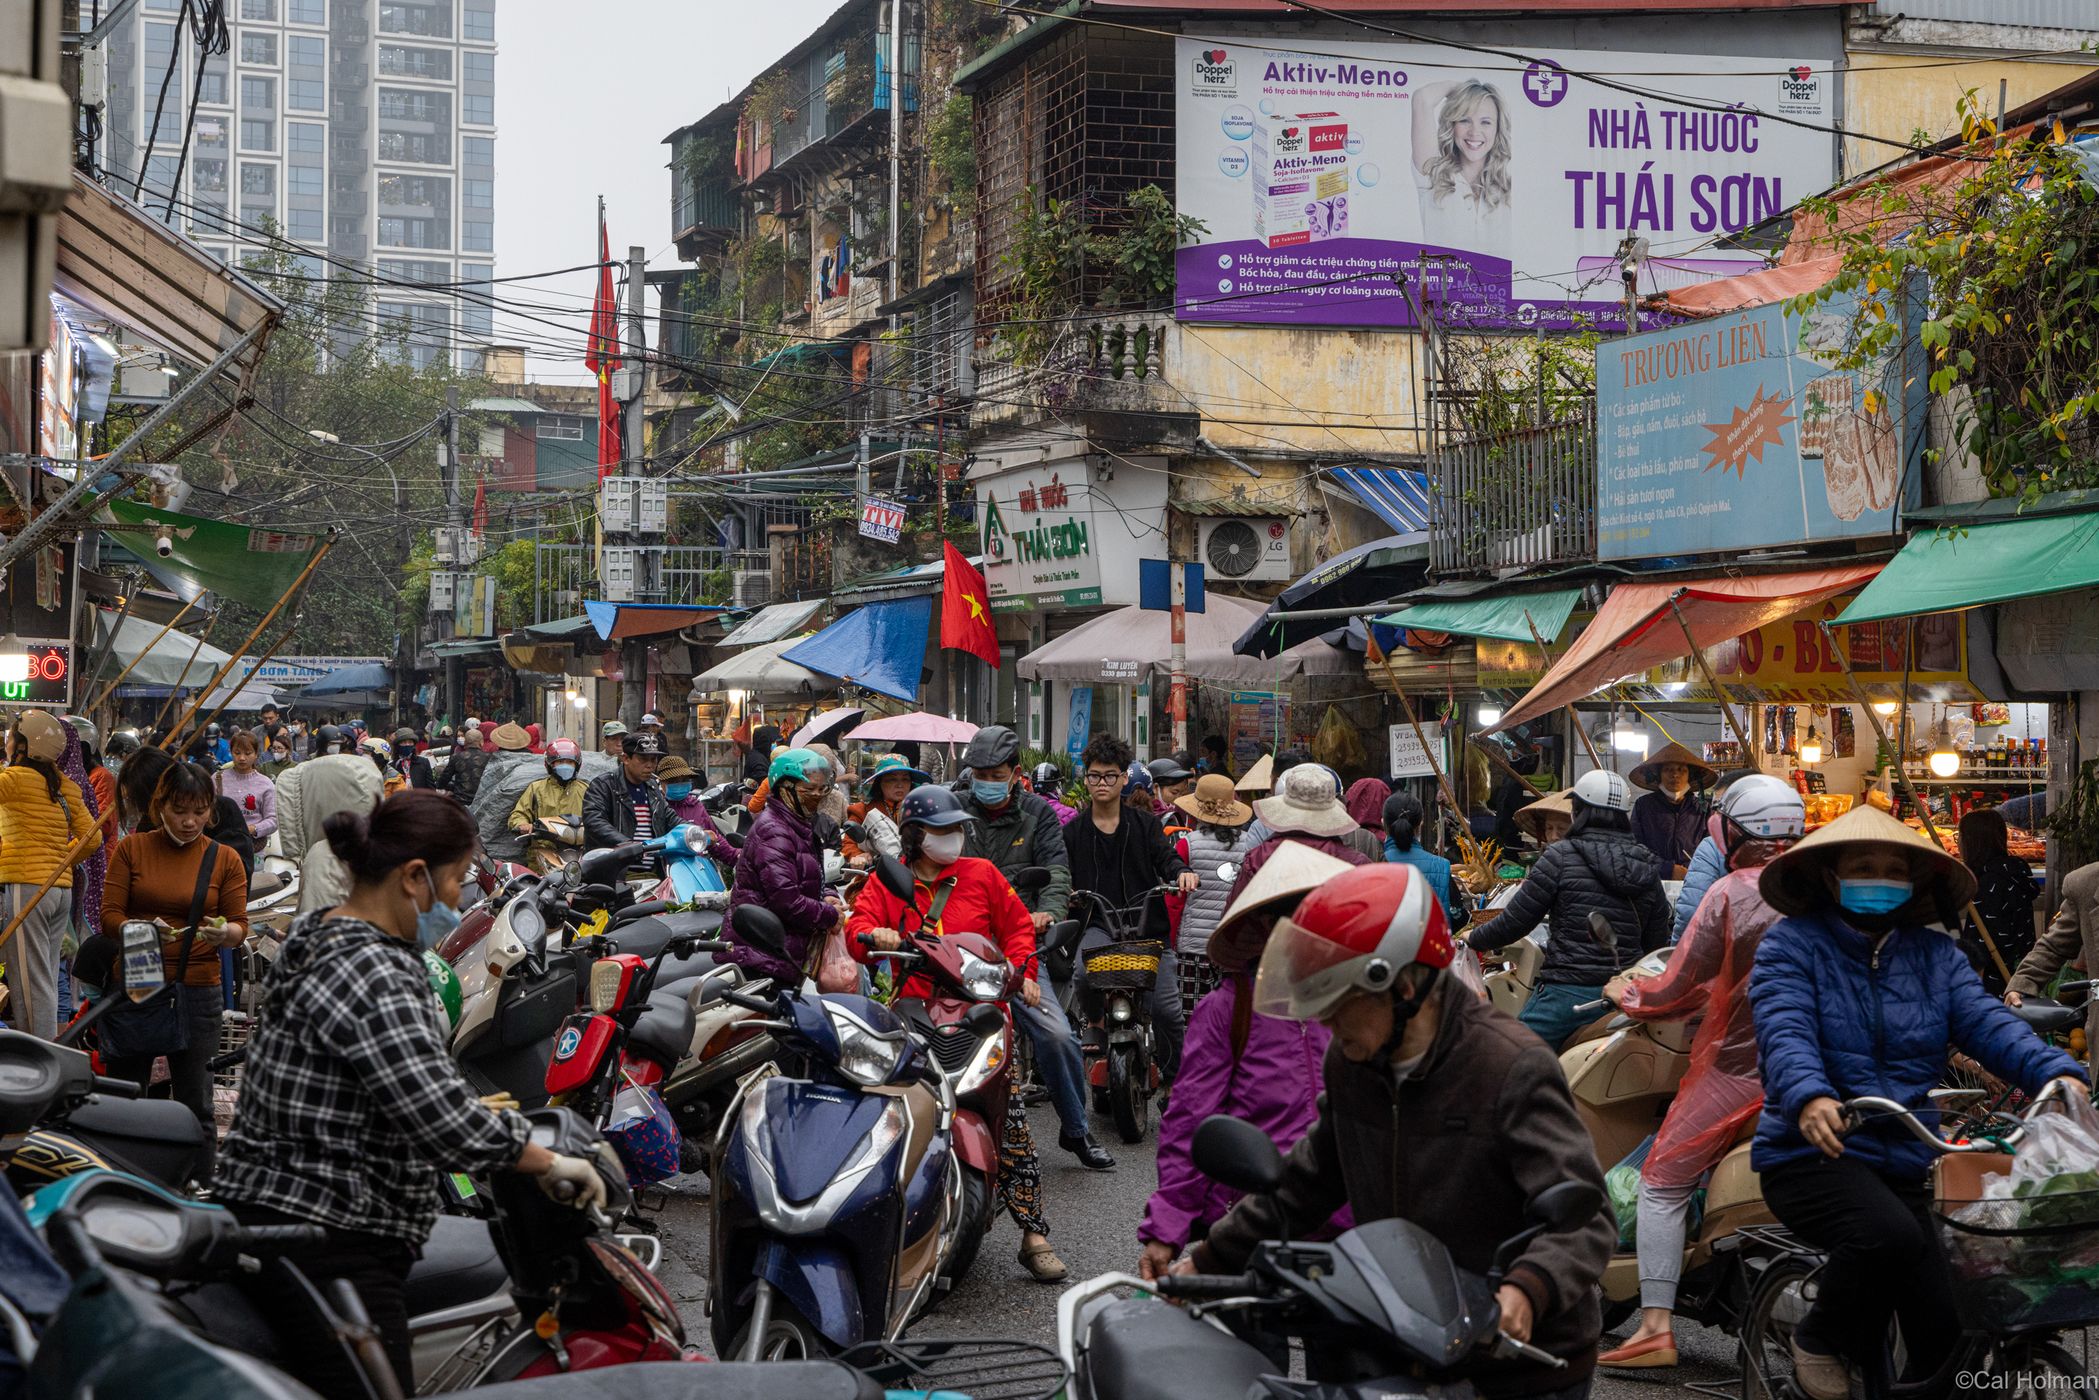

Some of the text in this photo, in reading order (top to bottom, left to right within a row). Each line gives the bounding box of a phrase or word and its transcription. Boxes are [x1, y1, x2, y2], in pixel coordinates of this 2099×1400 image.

[1196, 63, 1233, 78] Doppel
[1263, 61, 1408, 87] Aktiv-Meno
[1263, 86, 1273, 95] Hỗ
[1275, 88, 1285, 96] trợ
[1300, 88, 1318, 97] thiện
[1319, 89, 1336, 98] triệu
[1337, 90, 1360, 99] chứng
[1394, 92, 1409, 100] kinh
[1782, 79, 1817, 93] Doppel
[1588, 101, 1759, 153] NHÀ THUỐC
[1276, 138, 1303, 148] Doppel
[1314, 132, 1344, 143] aktiv
[1273, 154, 1347, 170] Aktiv-Meno
[1565, 160, 1782, 232] THÁI SƠN
[1239, 253, 1254, 265] Hỗ
[1256, 256, 1272, 267] trợ
[1273, 255, 1299, 268] giảm
[1301, 256, 1317, 266] các
[1319, 256, 1343, 268] triệu
[1346, 258, 1377, 270] chứng
[1379, 258, 1399, 268] tiền
[1239, 268, 1258, 279] Bốc
[1260, 268, 1282, 281] hỏa,
[1284, 269, 1303, 280] đau
[1305, 269, 1328, 282] đầu,
[1330, 271, 1348, 281] cáu
[1239, 280, 1254, 292] Hỗ
[1256, 283, 1272, 294] trợ
[1328, 286, 1342, 295] cơ
[1342, 284, 1365, 297] loãng
[1620, 313, 1768, 391] TRƯƠNG LIÊN
[1612, 403, 1626, 418] Các
[1656, 486, 1674, 504] ngon
[864, 504, 904, 530] TIVI
[1012, 517, 1052, 564] THÁI
[1270, 542, 1283, 551] LG
[805, 1092, 842, 1104] HONDA
